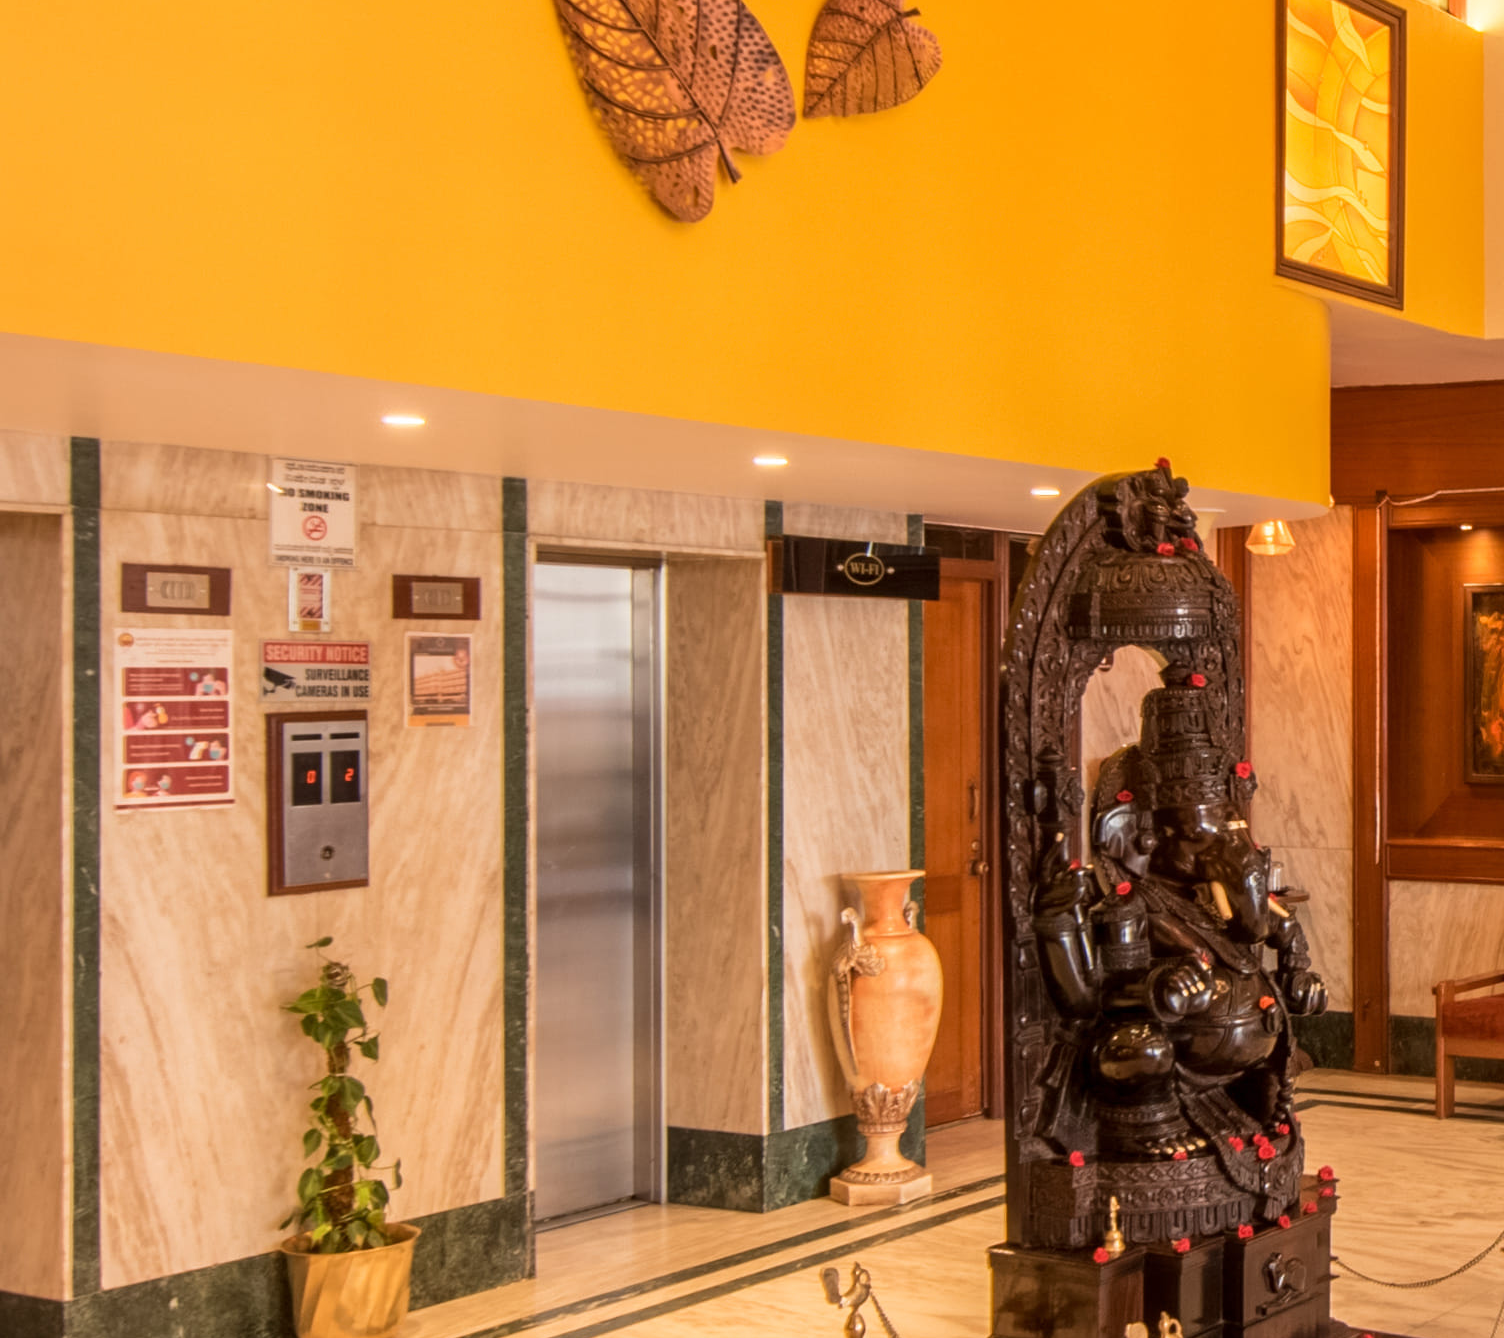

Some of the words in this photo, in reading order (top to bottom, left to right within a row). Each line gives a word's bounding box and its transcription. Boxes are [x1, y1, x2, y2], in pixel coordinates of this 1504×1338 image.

[299, 488, 350, 502] SMOKING
[301, 502, 329, 513] ZONE
[850, 561, 880, 576] WI-FI
[265, 644, 323, 661] SECURITY
[326, 645, 368, 662] NOTICE
[305, 668, 369, 681] SURVEILLANCE
[295, 685, 338, 698] CAMERAS
[341, 685, 350, 698] IN
[353, 685, 369, 698] USE
[344, 767, 355, 782] 2
